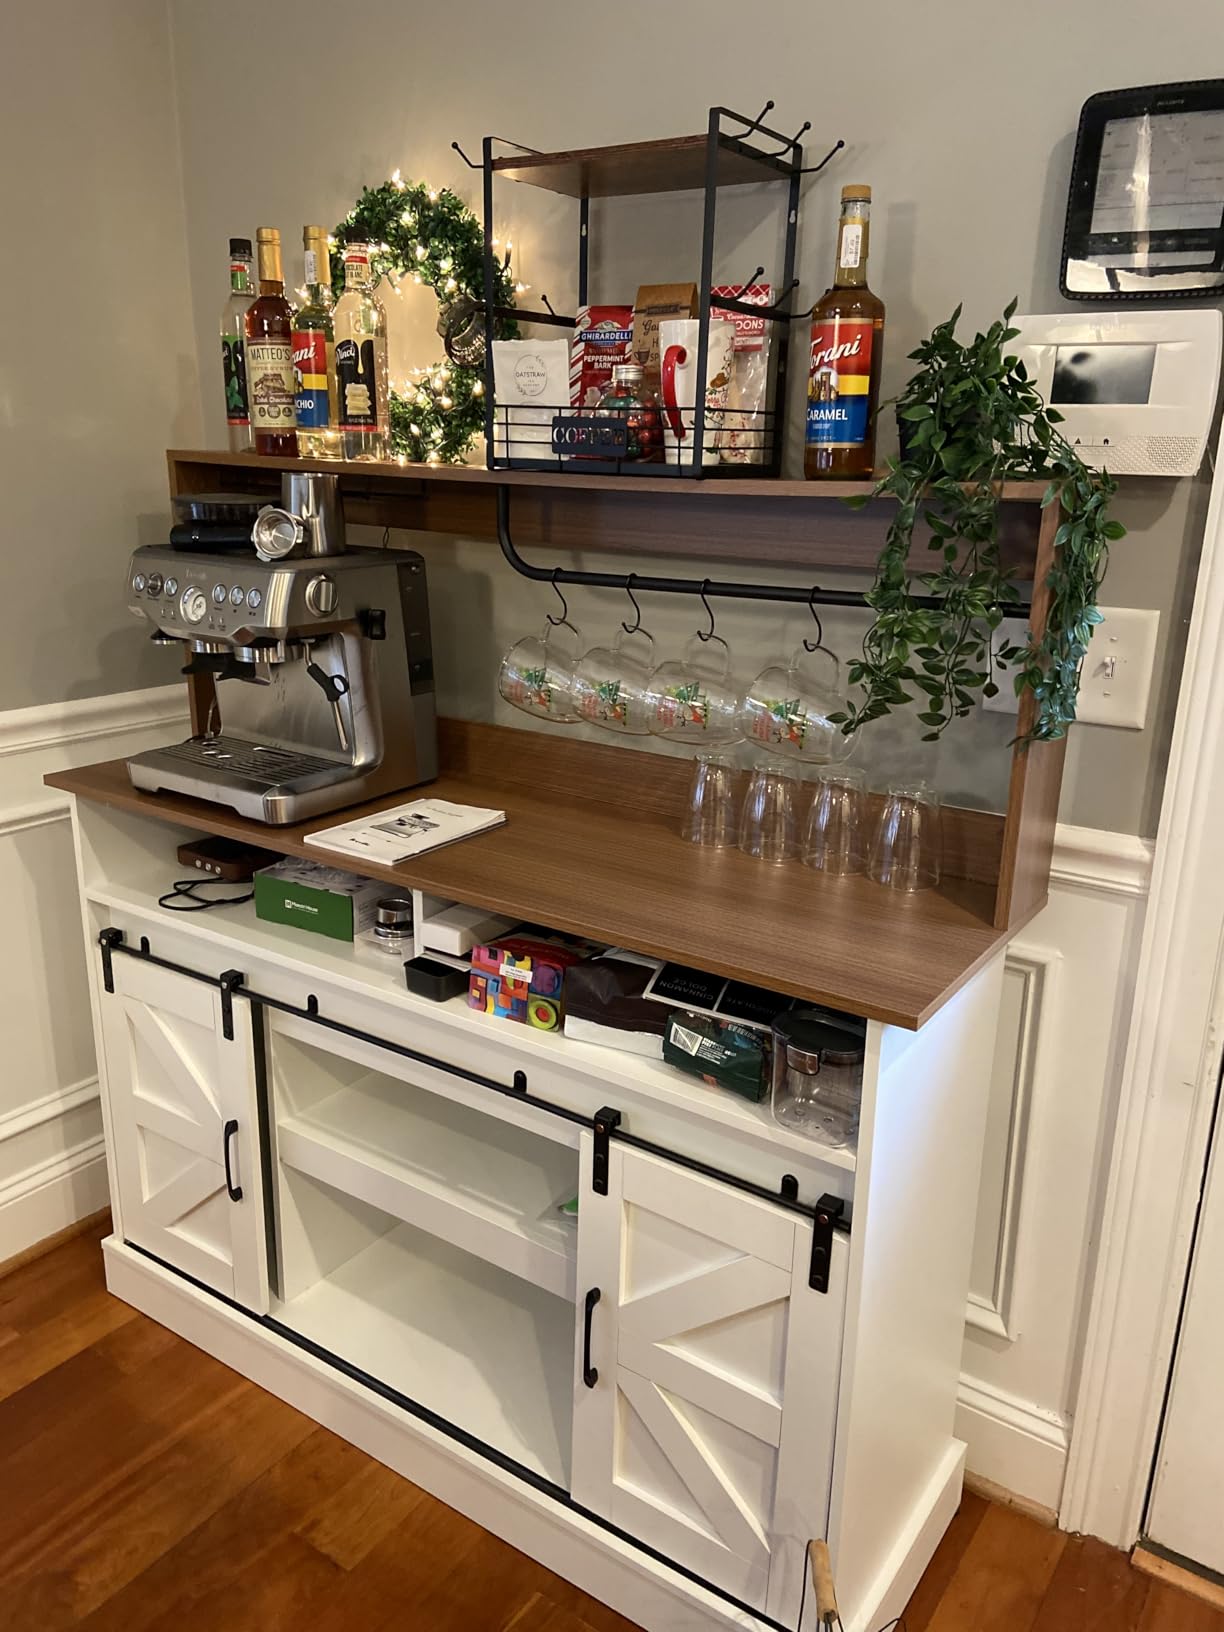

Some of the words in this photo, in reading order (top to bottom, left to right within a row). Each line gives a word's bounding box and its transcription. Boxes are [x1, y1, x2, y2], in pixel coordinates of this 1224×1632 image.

[581, 332, 632, 340] GHIRARDELLI
[250, 347, 291, 361] MATTEO'S
[296, 399, 314, 409] CHIO
[806, 408, 848, 421] CARAMEL
